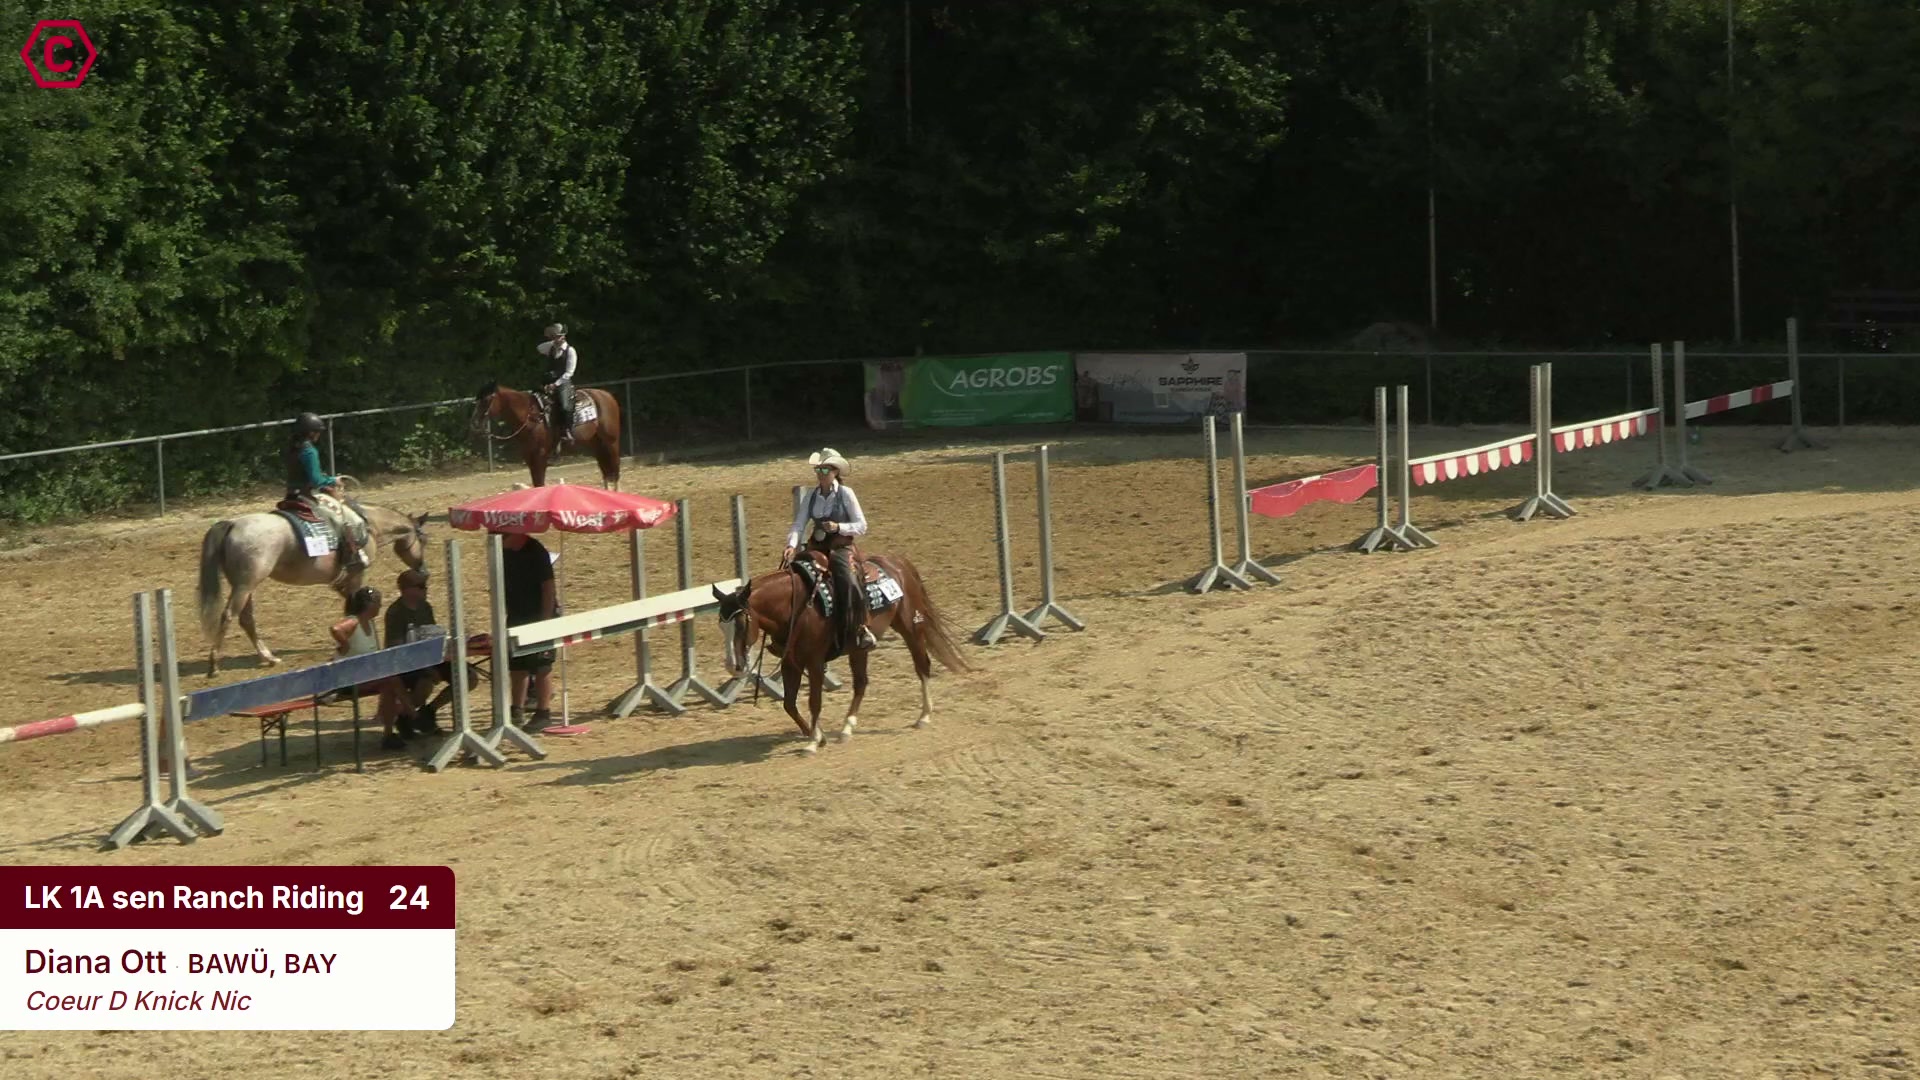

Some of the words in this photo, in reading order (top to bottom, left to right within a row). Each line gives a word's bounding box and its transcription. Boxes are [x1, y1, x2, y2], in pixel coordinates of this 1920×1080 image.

[1158, 376, 1224, 387] SAPPHIRE
[483, 509, 525, 527] West
[558, 509, 605, 527] West
